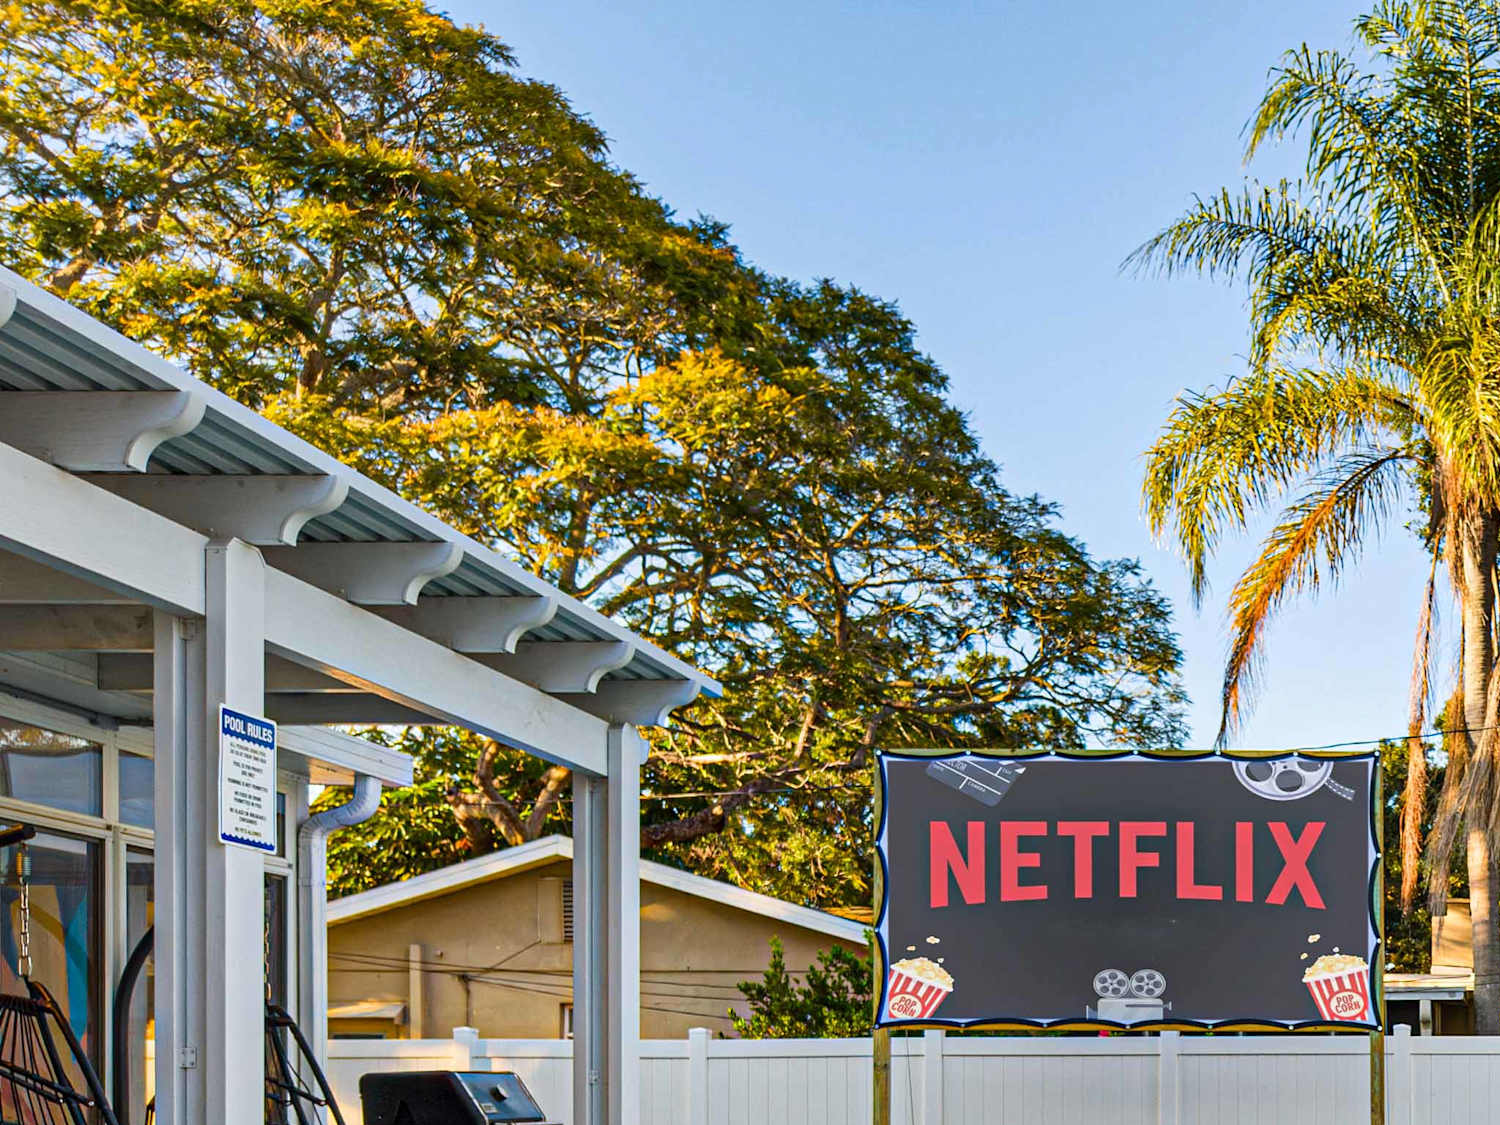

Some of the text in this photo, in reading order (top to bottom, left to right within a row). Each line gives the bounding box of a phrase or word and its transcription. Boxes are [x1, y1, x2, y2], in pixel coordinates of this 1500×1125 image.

[224, 715, 273, 743] POOL RULES
[930, 821, 1327, 909] NETFLIX
[899, 996, 917, 1009] POP
[1335, 1001, 1361, 1014] CORN
[1336, 994, 1354, 1007] POP
[891, 1002, 916, 1017] CORN
